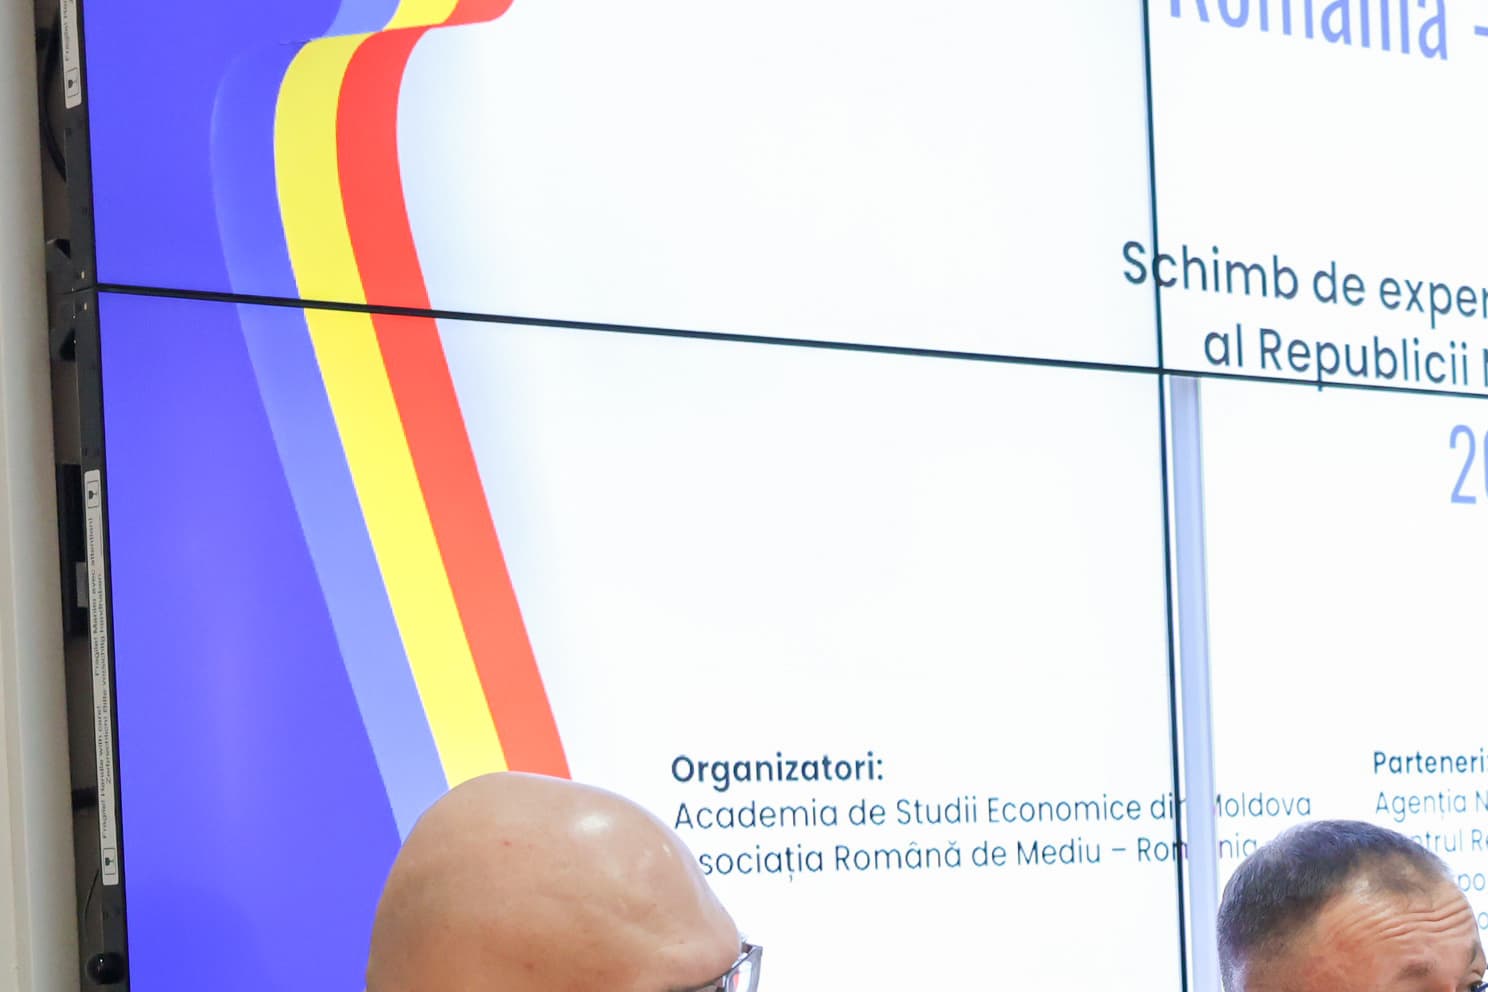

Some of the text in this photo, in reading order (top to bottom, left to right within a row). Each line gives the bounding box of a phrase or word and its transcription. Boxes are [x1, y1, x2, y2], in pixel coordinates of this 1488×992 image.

[1122, 241, 1299, 299] Schimb
[1313, 261, 1365, 306] de
[1204, 323, 1243, 367] al
[1259, 328, 1468, 391] Republicii
[671, 751, 883, 792] Organizatori:
[675, 798, 838, 829] Academia
[849, 798, 886, 826] de
[897, 795, 977, 825] Studii
[988, 794, 1141, 823] Economice
[699, 844, 823, 882] sociația
[835, 840, 961, 872] Română
[972, 839, 1007, 867] de
[1017, 837, 1100, 866] Mediu
[1137, 832, 1257, 862] Romnia
